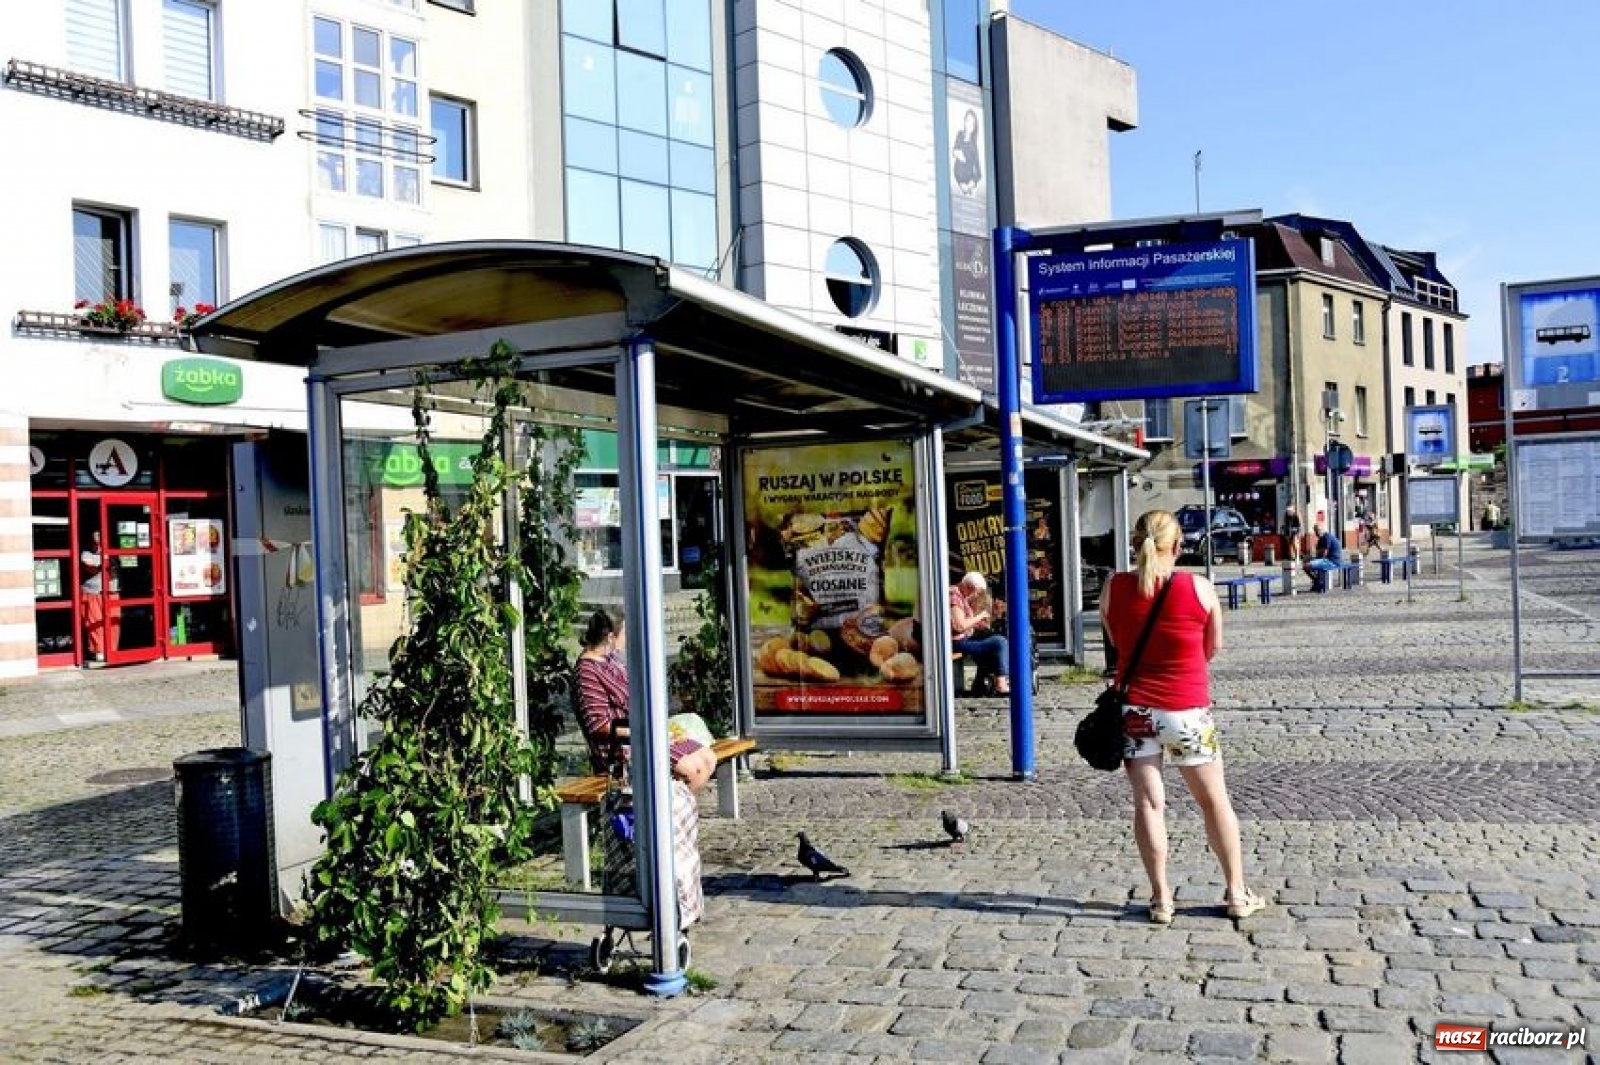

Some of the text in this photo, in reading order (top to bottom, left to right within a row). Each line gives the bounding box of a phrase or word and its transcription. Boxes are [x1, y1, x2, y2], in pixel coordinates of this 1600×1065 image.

[1038, 247, 1236, 277] System Informacji Pasażerskiej
[174, 364, 236, 387] żabka
[1556, 366, 1569, 383] 2
[758, 474, 816, 492] RUSZAJ
[819, 471, 835, 488] W
[804, 550, 870, 567] WIEJSKIE
[810, 577, 867, 592] CIOSANE
